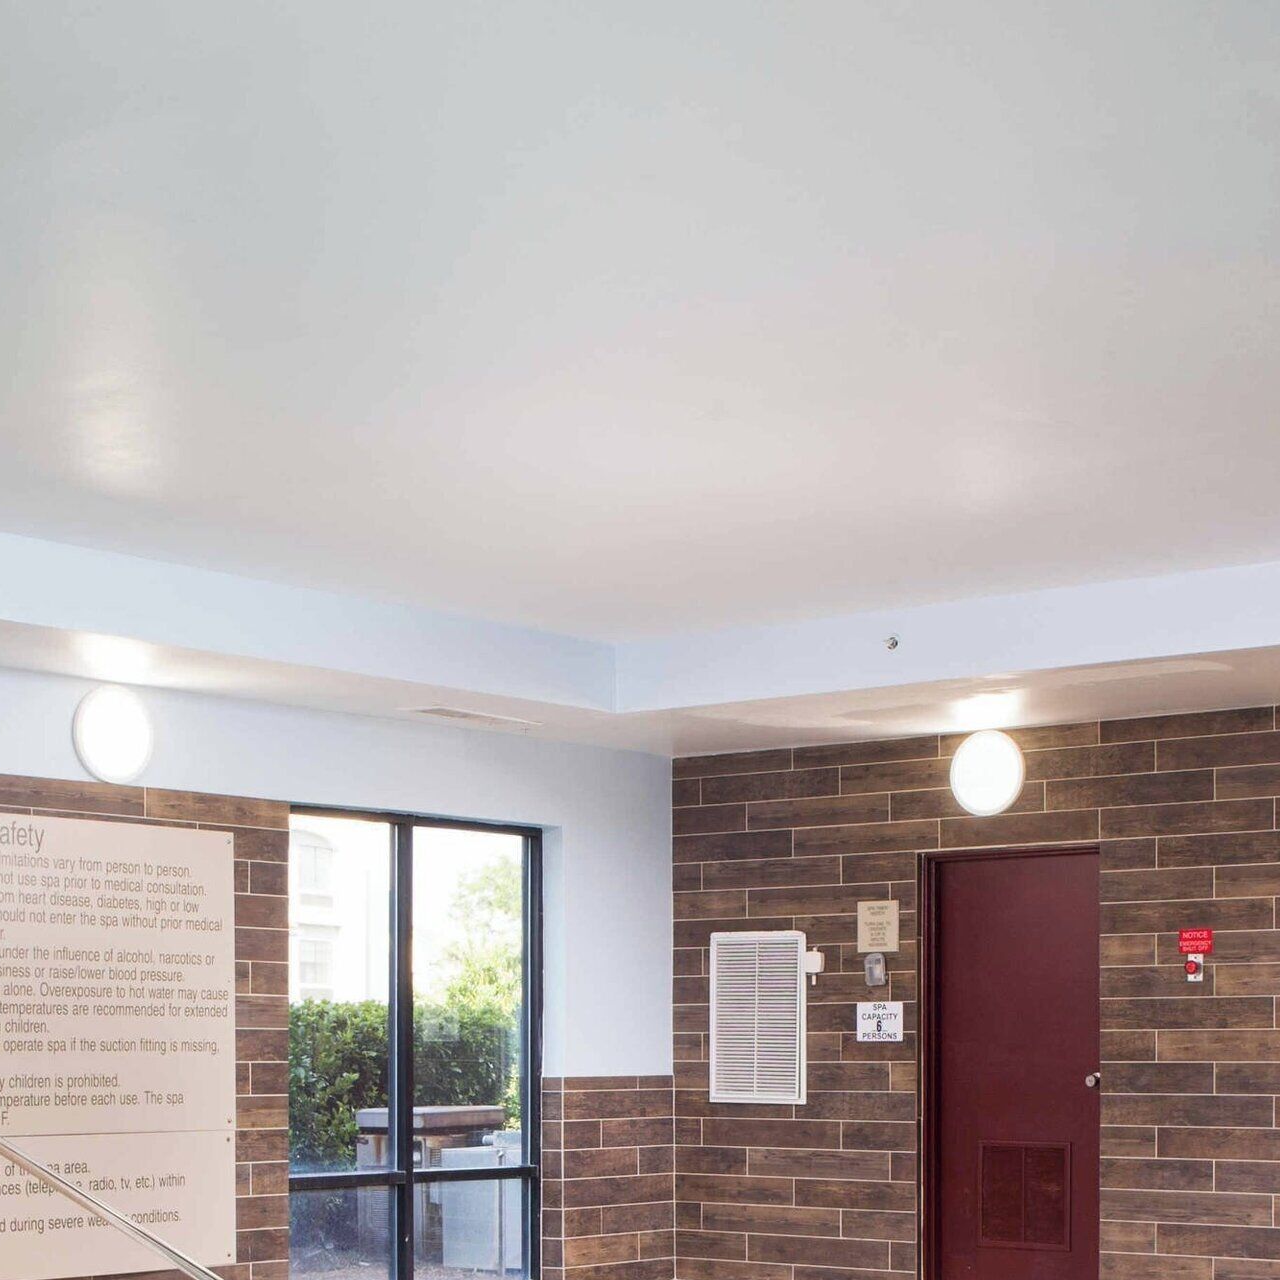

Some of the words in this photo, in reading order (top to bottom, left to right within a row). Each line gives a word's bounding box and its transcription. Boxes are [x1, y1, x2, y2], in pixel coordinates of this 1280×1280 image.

[872, 1003, 887, 1011] SPA
[876, 1020, 882, 1032] 6
[862, 1032, 898, 1040] PERSONS
[8, 1075, 51, 1088] children
[55, 1077, 64, 1088] is
[67, 1074, 121, 1091] prohibited.
[54, 1092, 88, 1106] before
[91, 1092, 116, 1105] each
[120, 1094, 140, 1105] use.
[144, 1091, 163, 1104] The
[166, 1093, 184, 1106] spa
[1, 1111, 10, 1125] F.
[4, 1162, 19, 1176] of
[64, 1162, 91, 1174] area.
[89, 1177, 117, 1191] radio,
[159, 1174, 186, 1187] within
[10, 1217, 45, 1233] during
[48, 1217, 84, 1229] severe
[130, 1210, 181, 1224] conditions.
